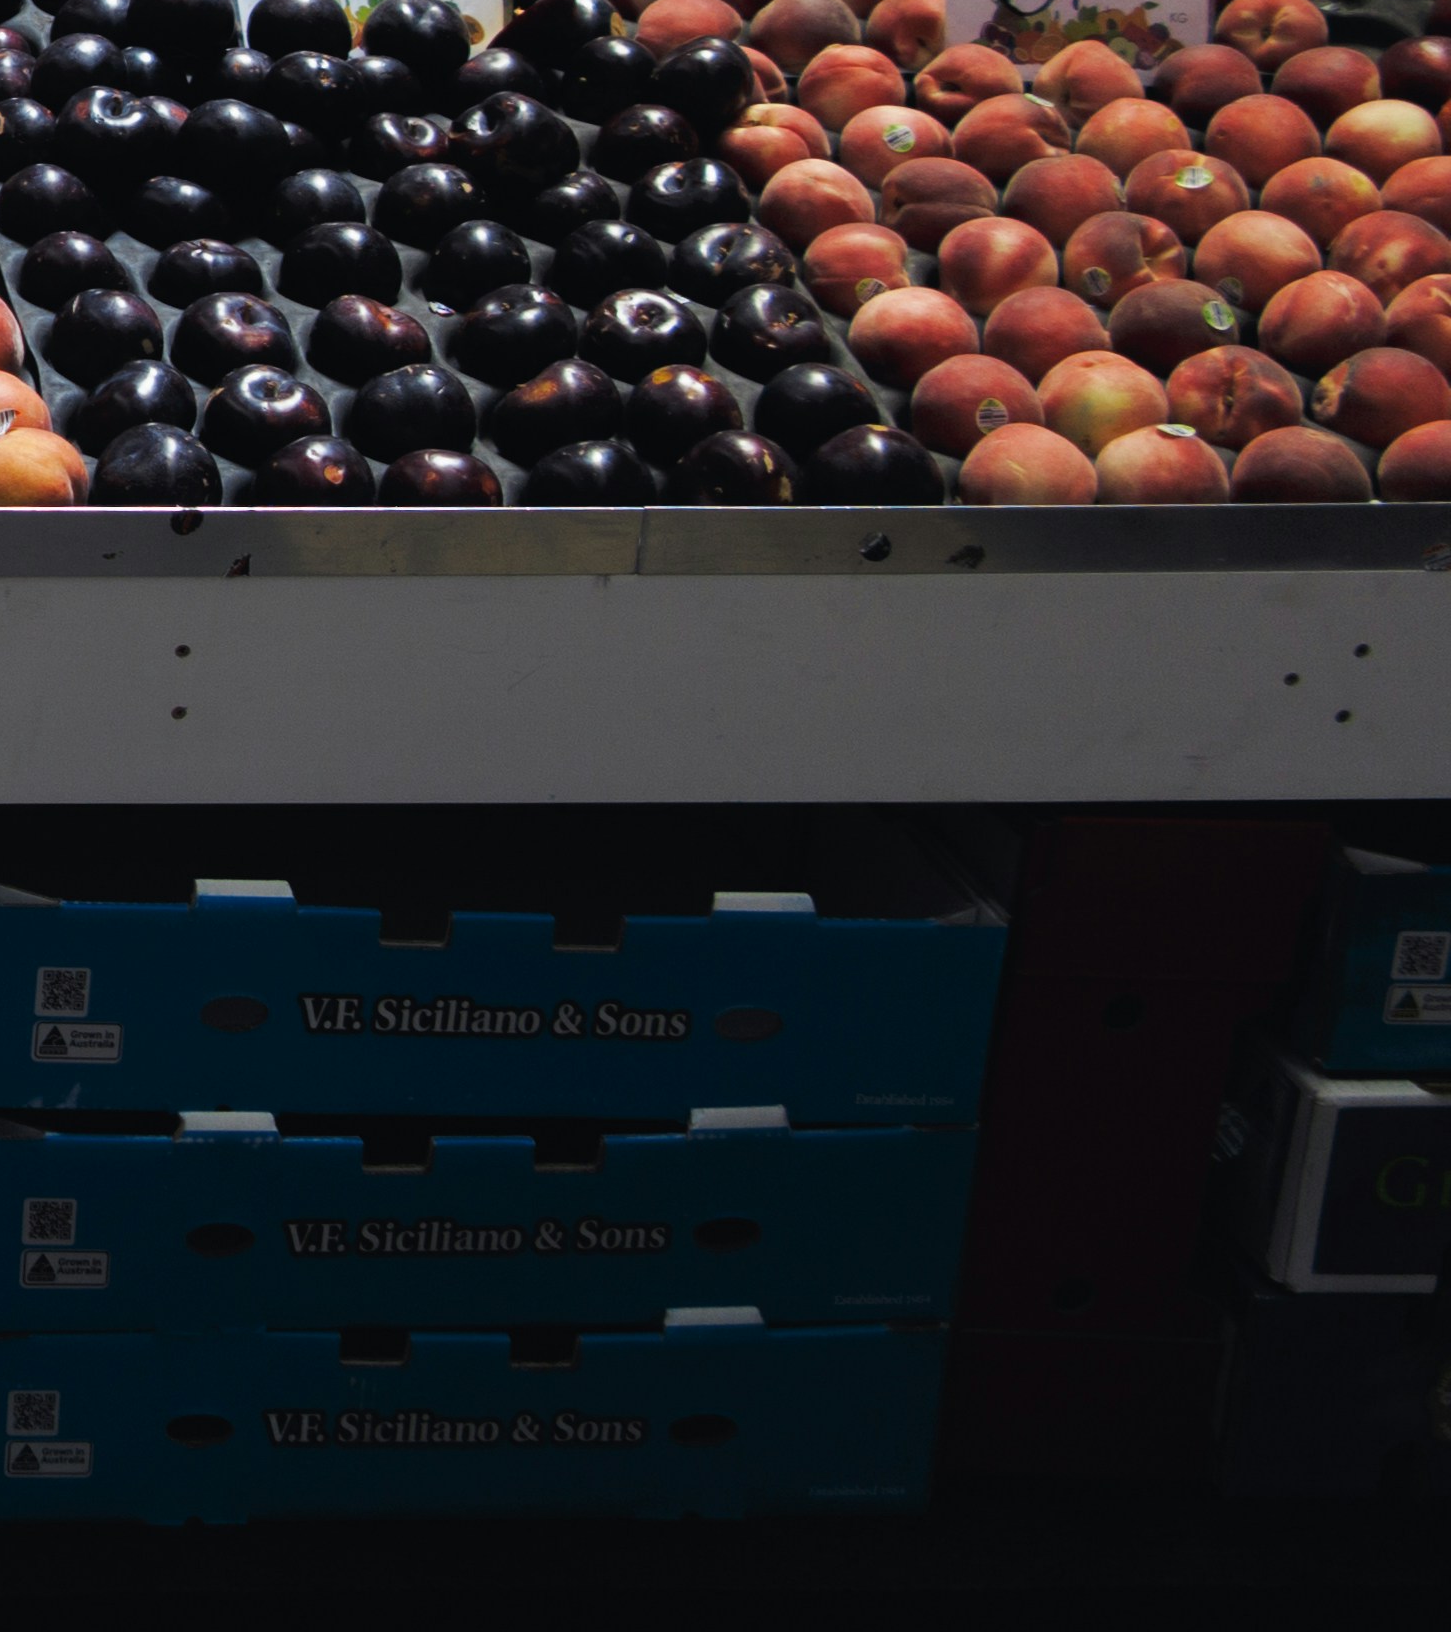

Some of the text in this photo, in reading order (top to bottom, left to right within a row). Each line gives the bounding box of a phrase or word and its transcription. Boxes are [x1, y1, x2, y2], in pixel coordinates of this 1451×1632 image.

[1170, 12, 1188, 24] KG
[303, 997, 687, 1037] V.F. Siciliano & Sons
[70, 1030, 114, 1040] Grown in
[70, 1038, 114, 1049] Australia
[288, 1220, 665, 1253] V.F. Siciliano & Sons
[58, 1258, 102, 1267] Grown in
[57, 1265, 102, 1276] Australia
[267, 1412, 642, 1443] V.F. Siciliano & Sons
[42, 1447, 85, 1457] Grown in
[41, 1455, 85, 1465] Australia
